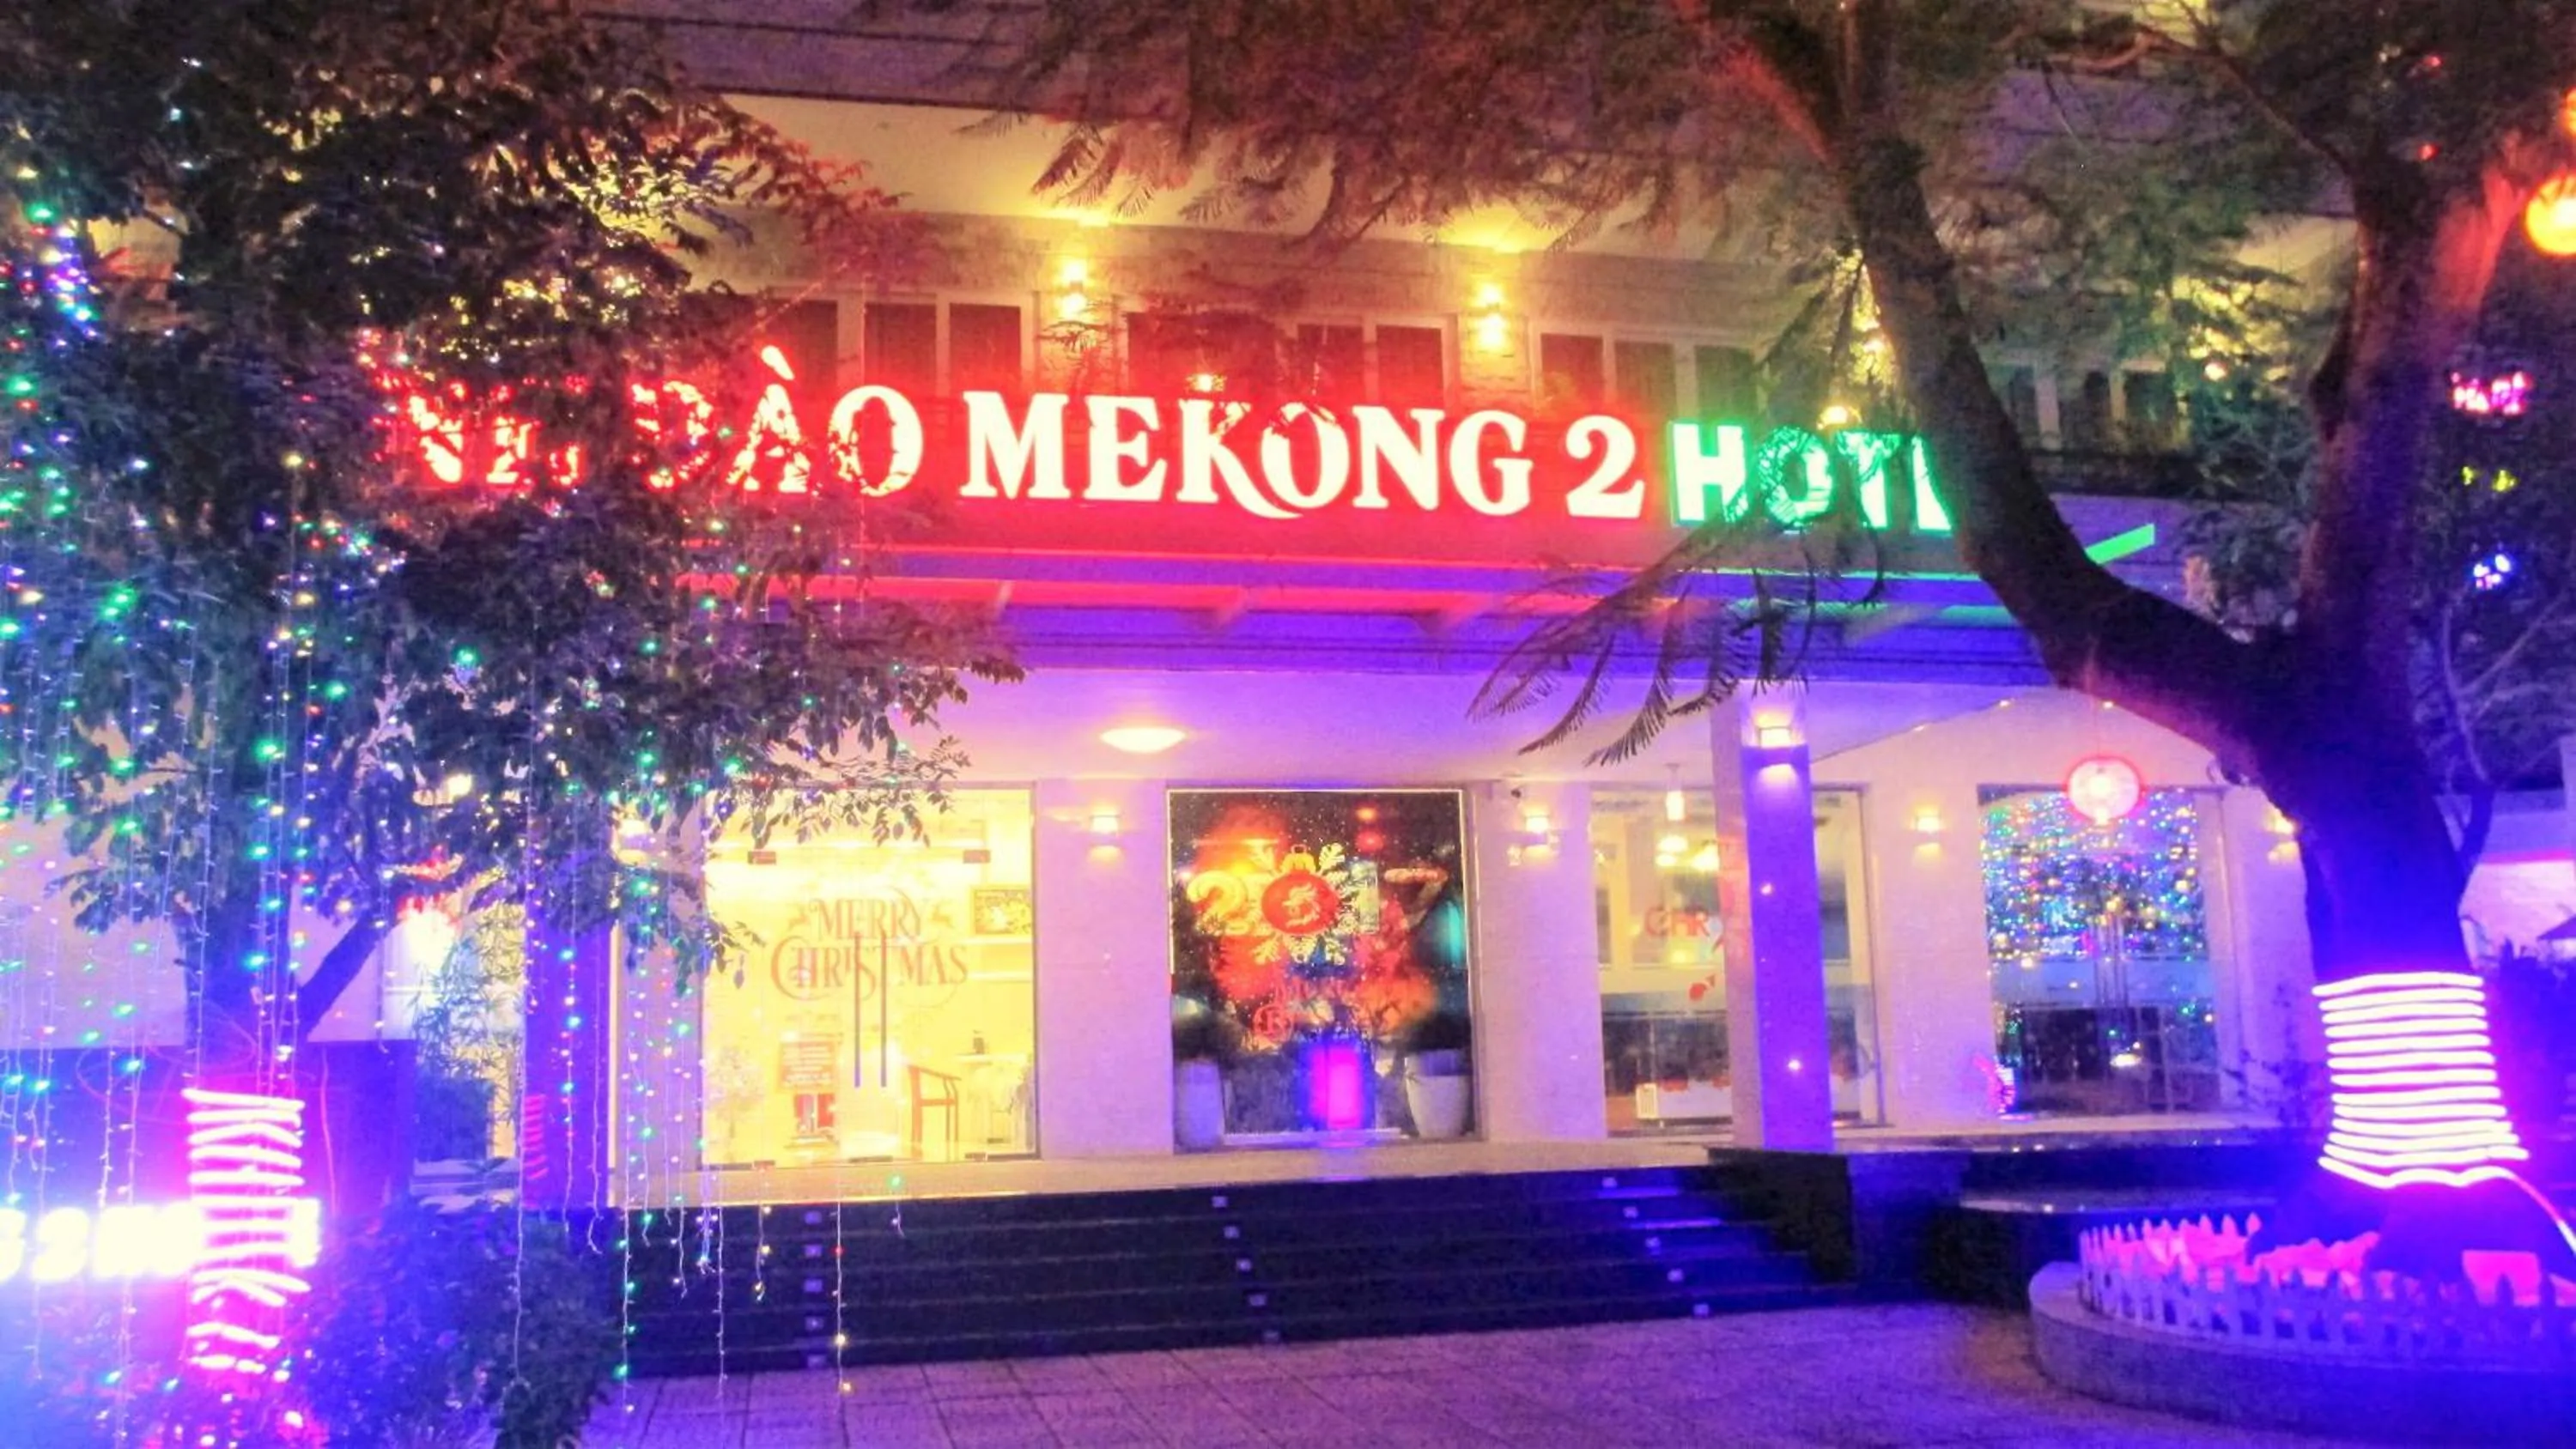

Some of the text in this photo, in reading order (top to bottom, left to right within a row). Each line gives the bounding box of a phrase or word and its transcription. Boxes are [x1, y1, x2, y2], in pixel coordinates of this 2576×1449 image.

[959, 391, 1534, 518] MEKONG
[1564, 415, 1645, 519] 2
[809, 888, 925, 943] MERRY
[770, 935, 969, 1002] CHRISTMAS
